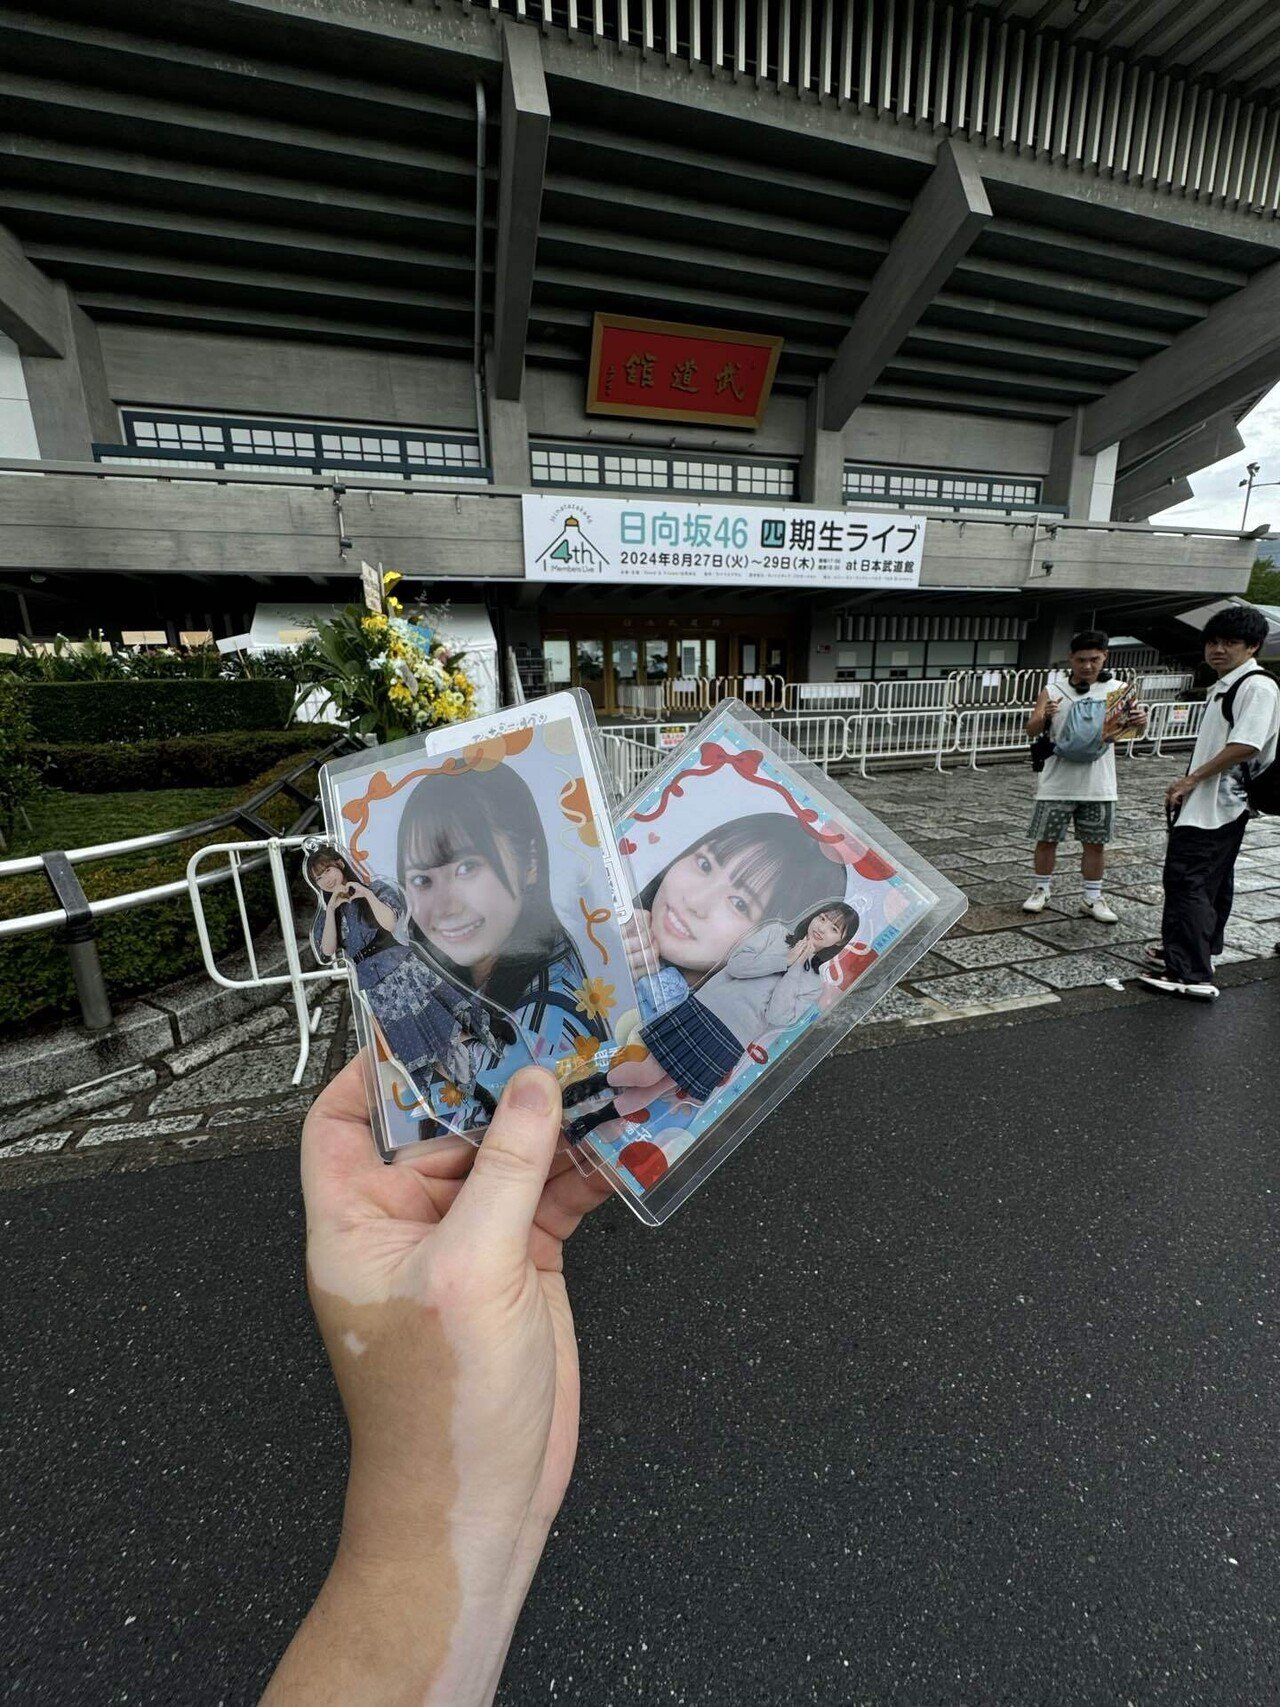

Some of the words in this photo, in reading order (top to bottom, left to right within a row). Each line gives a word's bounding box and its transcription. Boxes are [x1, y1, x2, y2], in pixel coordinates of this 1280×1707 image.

[620, 511, 748, 549] 日向坂46
[760, 518, 921, 554] 四期生ライブ
[550, 539, 595, 564] 4th
[846, 560, 857, 571] at
[860, 559, 915, 573] 日本武道館
